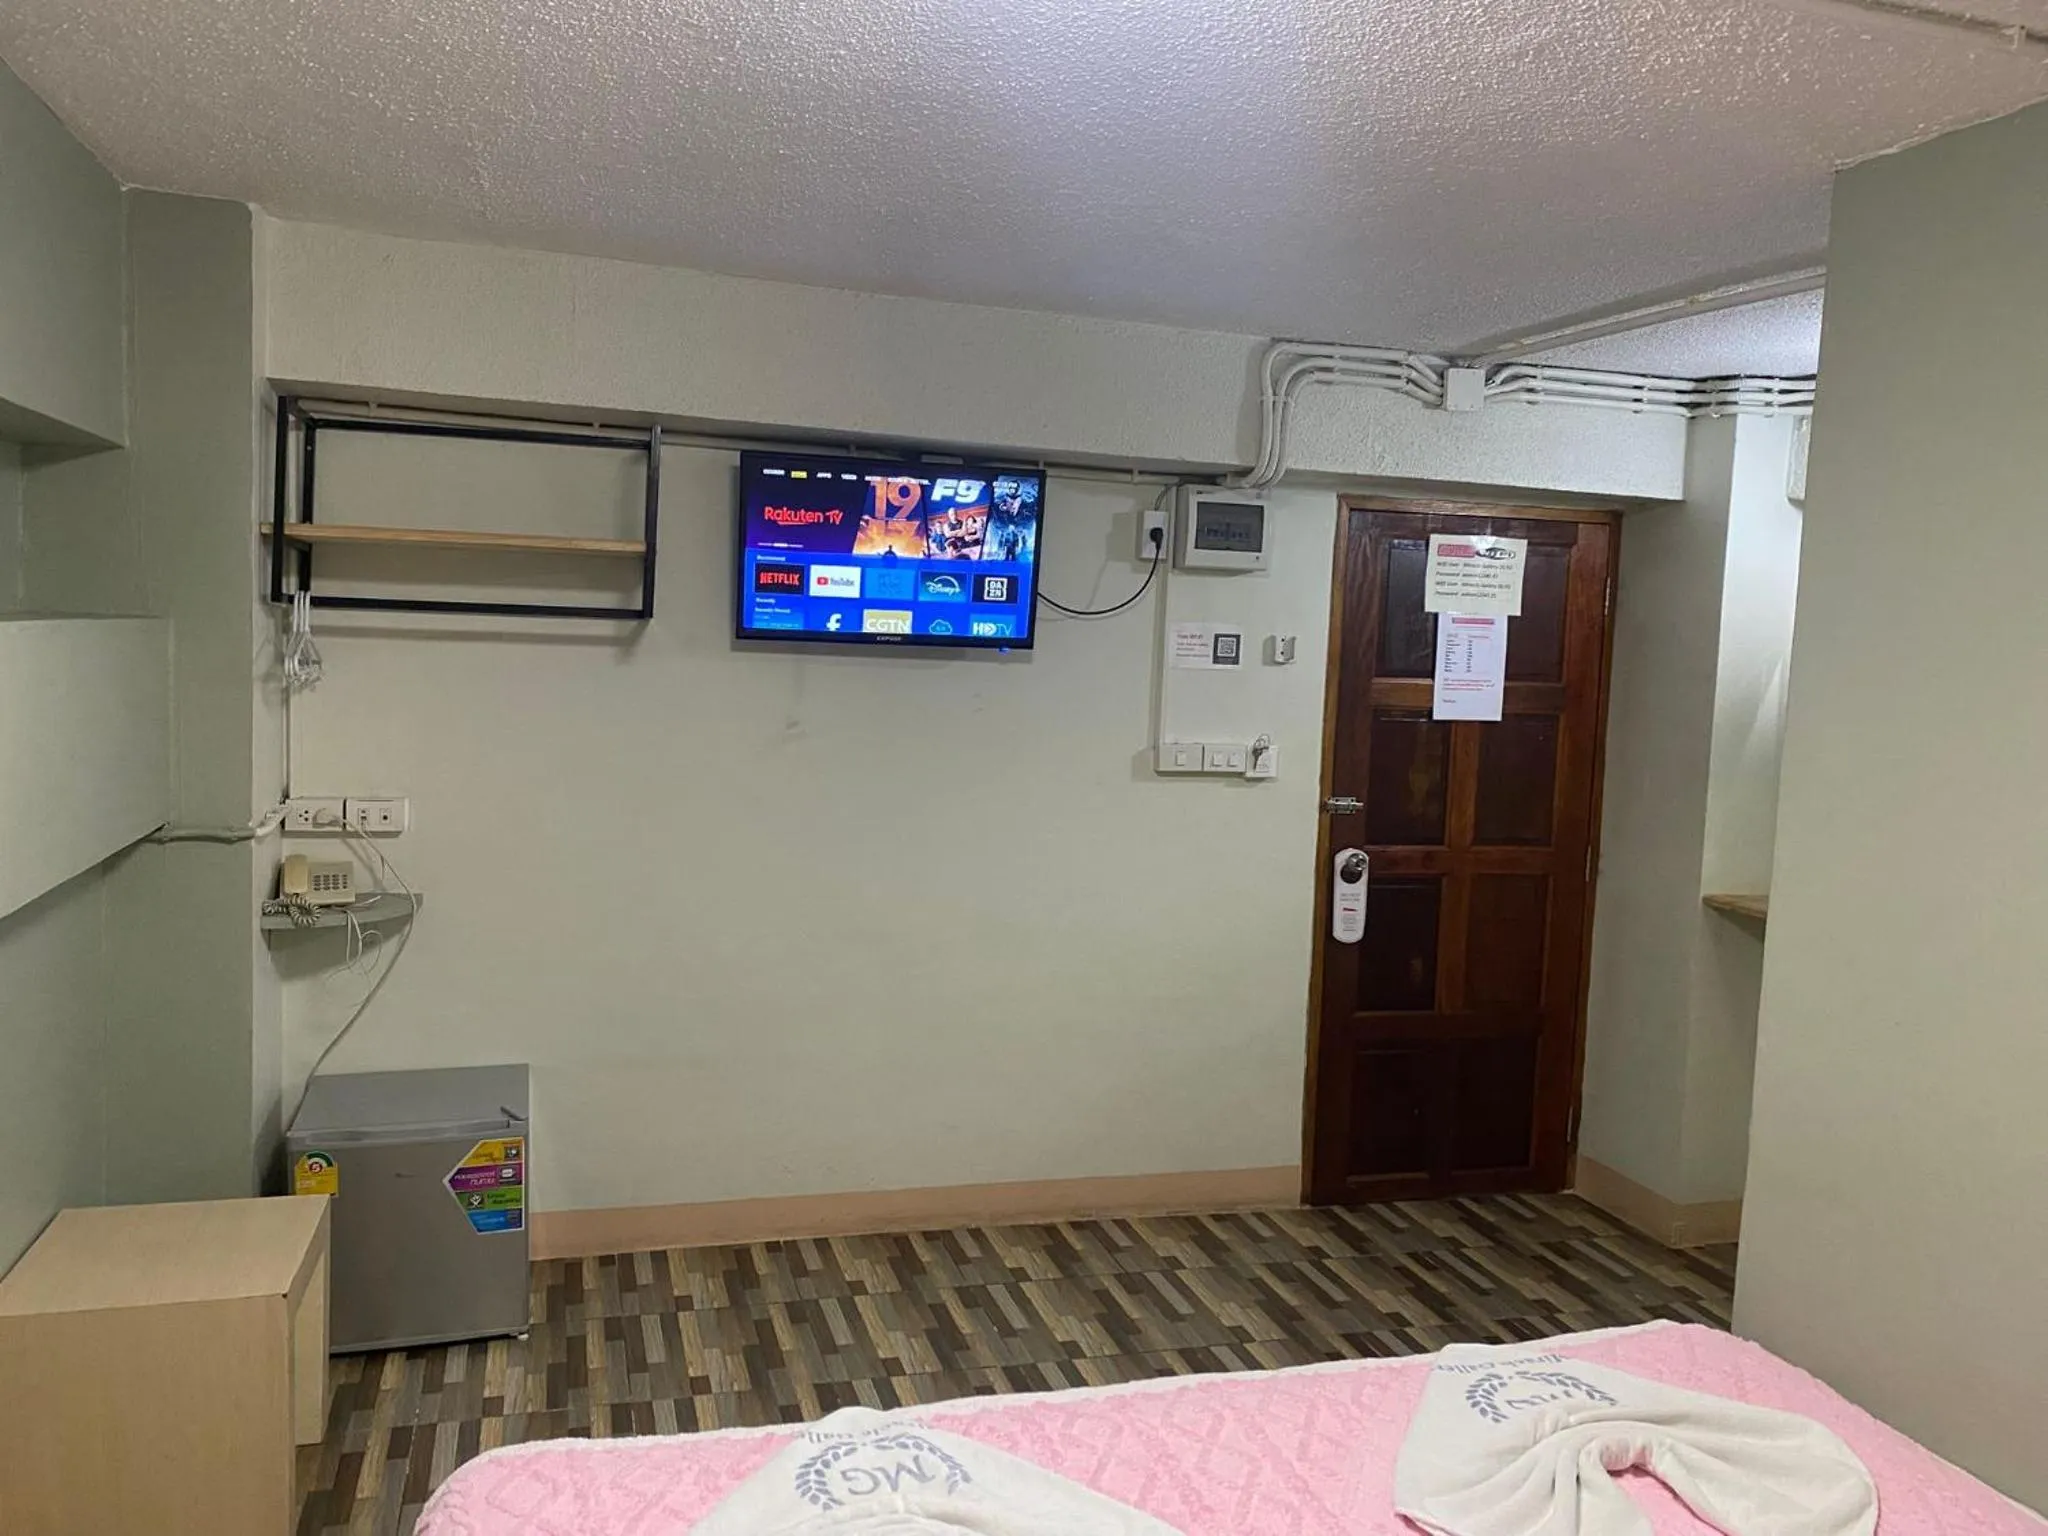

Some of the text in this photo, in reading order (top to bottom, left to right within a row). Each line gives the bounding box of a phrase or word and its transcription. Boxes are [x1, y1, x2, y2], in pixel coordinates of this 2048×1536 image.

[870, 477, 921, 520] 19
[931, 478, 987, 503] F9
[764, 506, 843, 525] Rakuten TV
[759, 572, 800, 586] NETFLIX
[830, 577, 855, 587] YouTube
[867, 618, 911, 633] CGTN
[839, 1454, 937, 1495] MG
